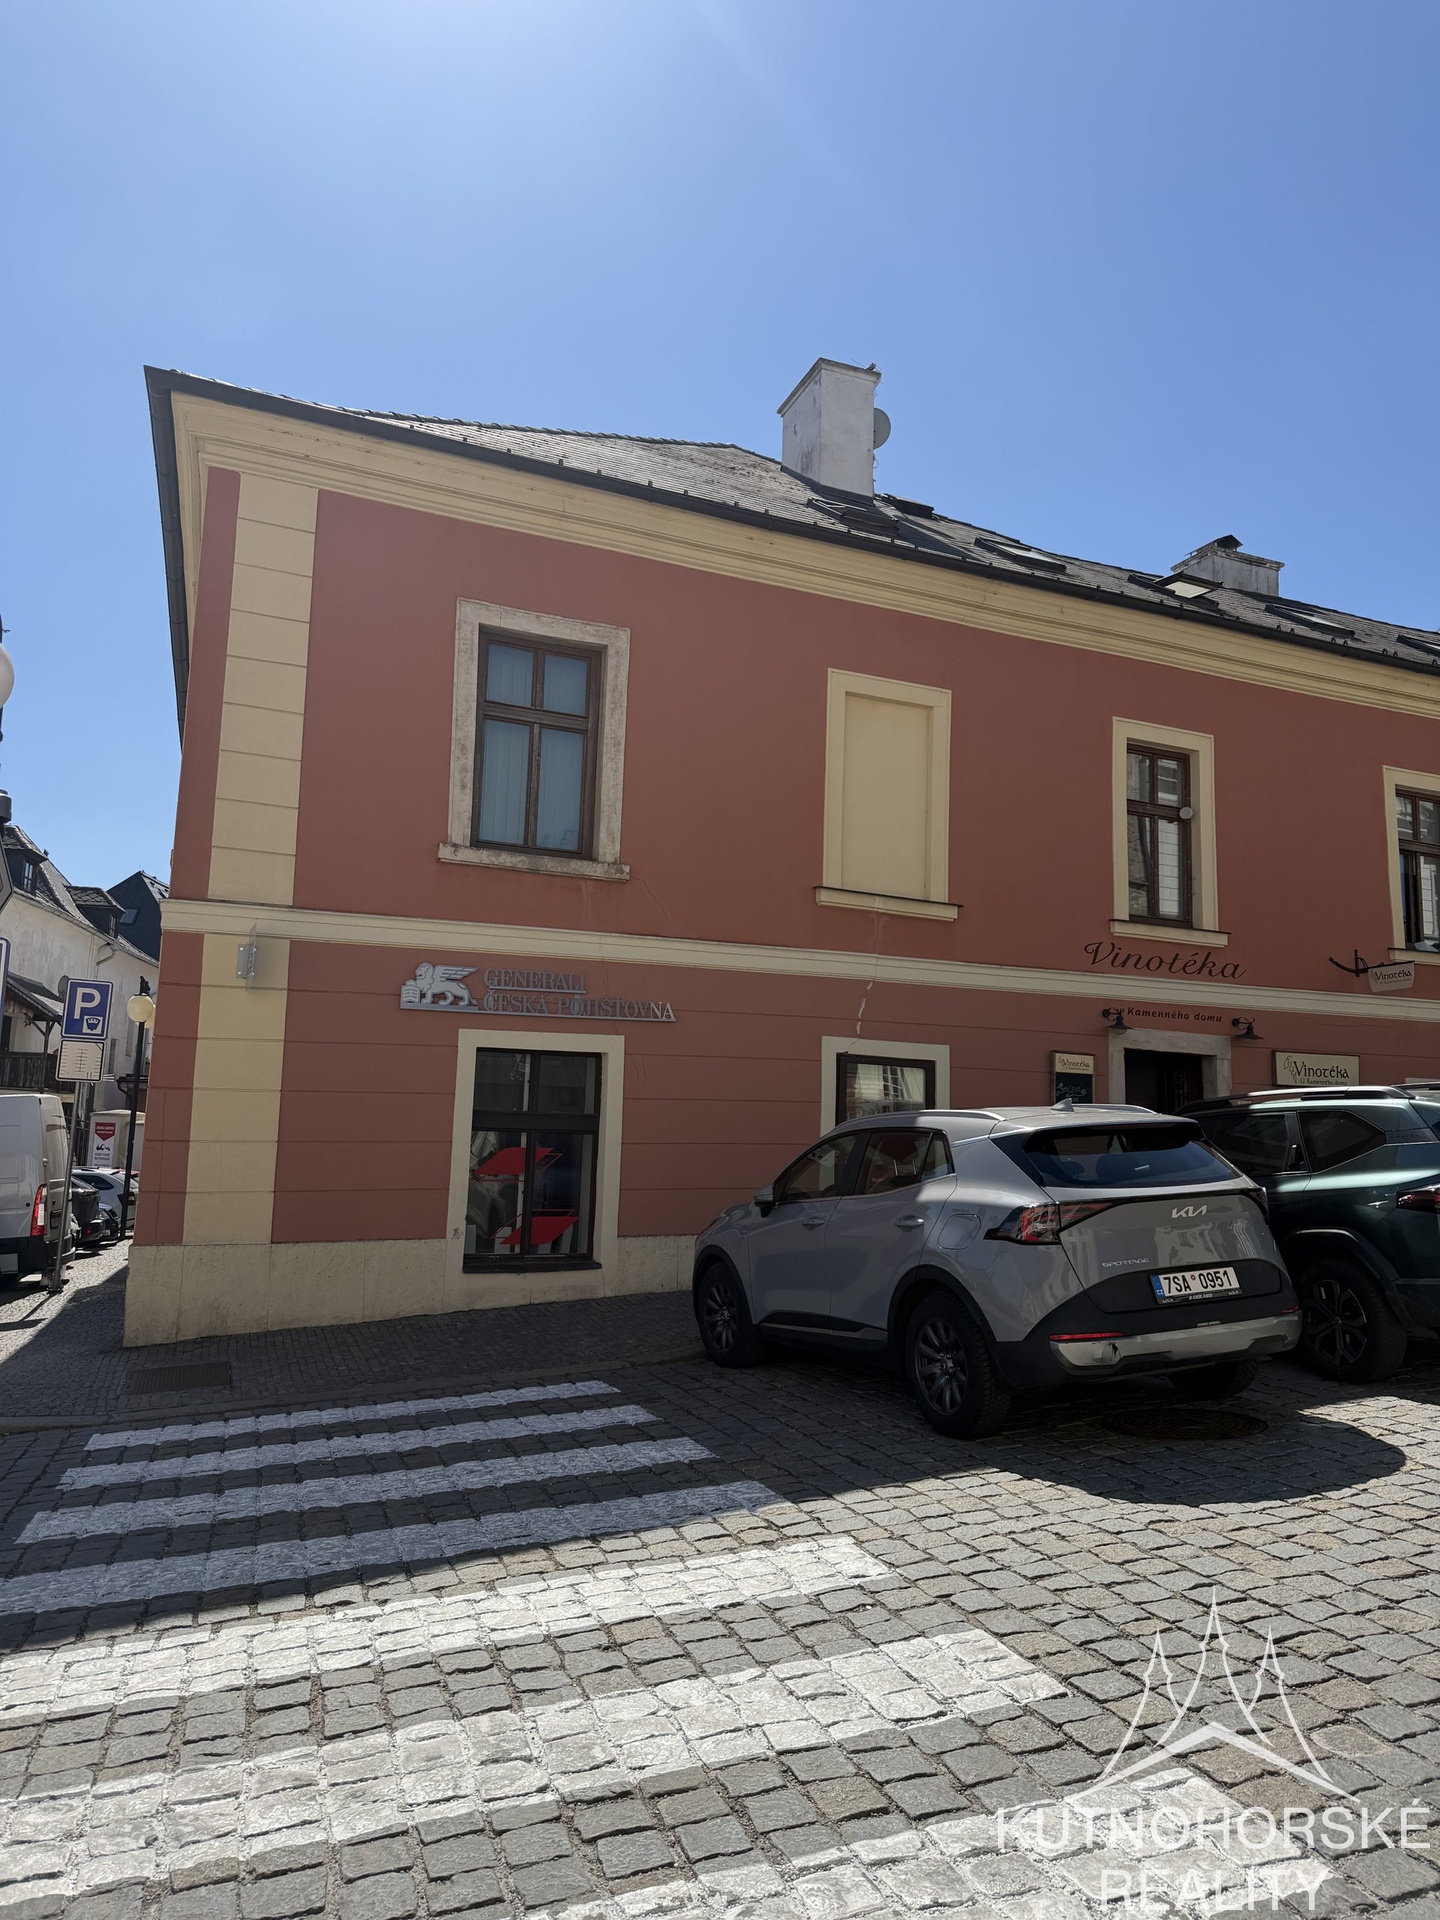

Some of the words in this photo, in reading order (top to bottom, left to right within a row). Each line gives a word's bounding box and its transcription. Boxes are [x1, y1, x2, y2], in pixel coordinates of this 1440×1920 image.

[1084, 941, 1247, 979] Vinotéka
[483, 968, 585, 991] GENERALI
[74, 987, 101, 1019] P
[483, 989, 548, 1014] ČESKÁ
[557, 996, 676, 1020] POJIŠŤOVNA
[1127, 1006, 1190, 1020] Kamenného
[1194, 1011, 1222, 1022] domu
[1293, 1060, 1349, 1079] Vinotéka
[1171, 1204, 1207, 1219] KIA
[1102, 1257, 1149, 1268] SPORTAGE
[1163, 1274, 1192, 1294] 7SA
[1198, 1269, 1232, 1290] 0951
